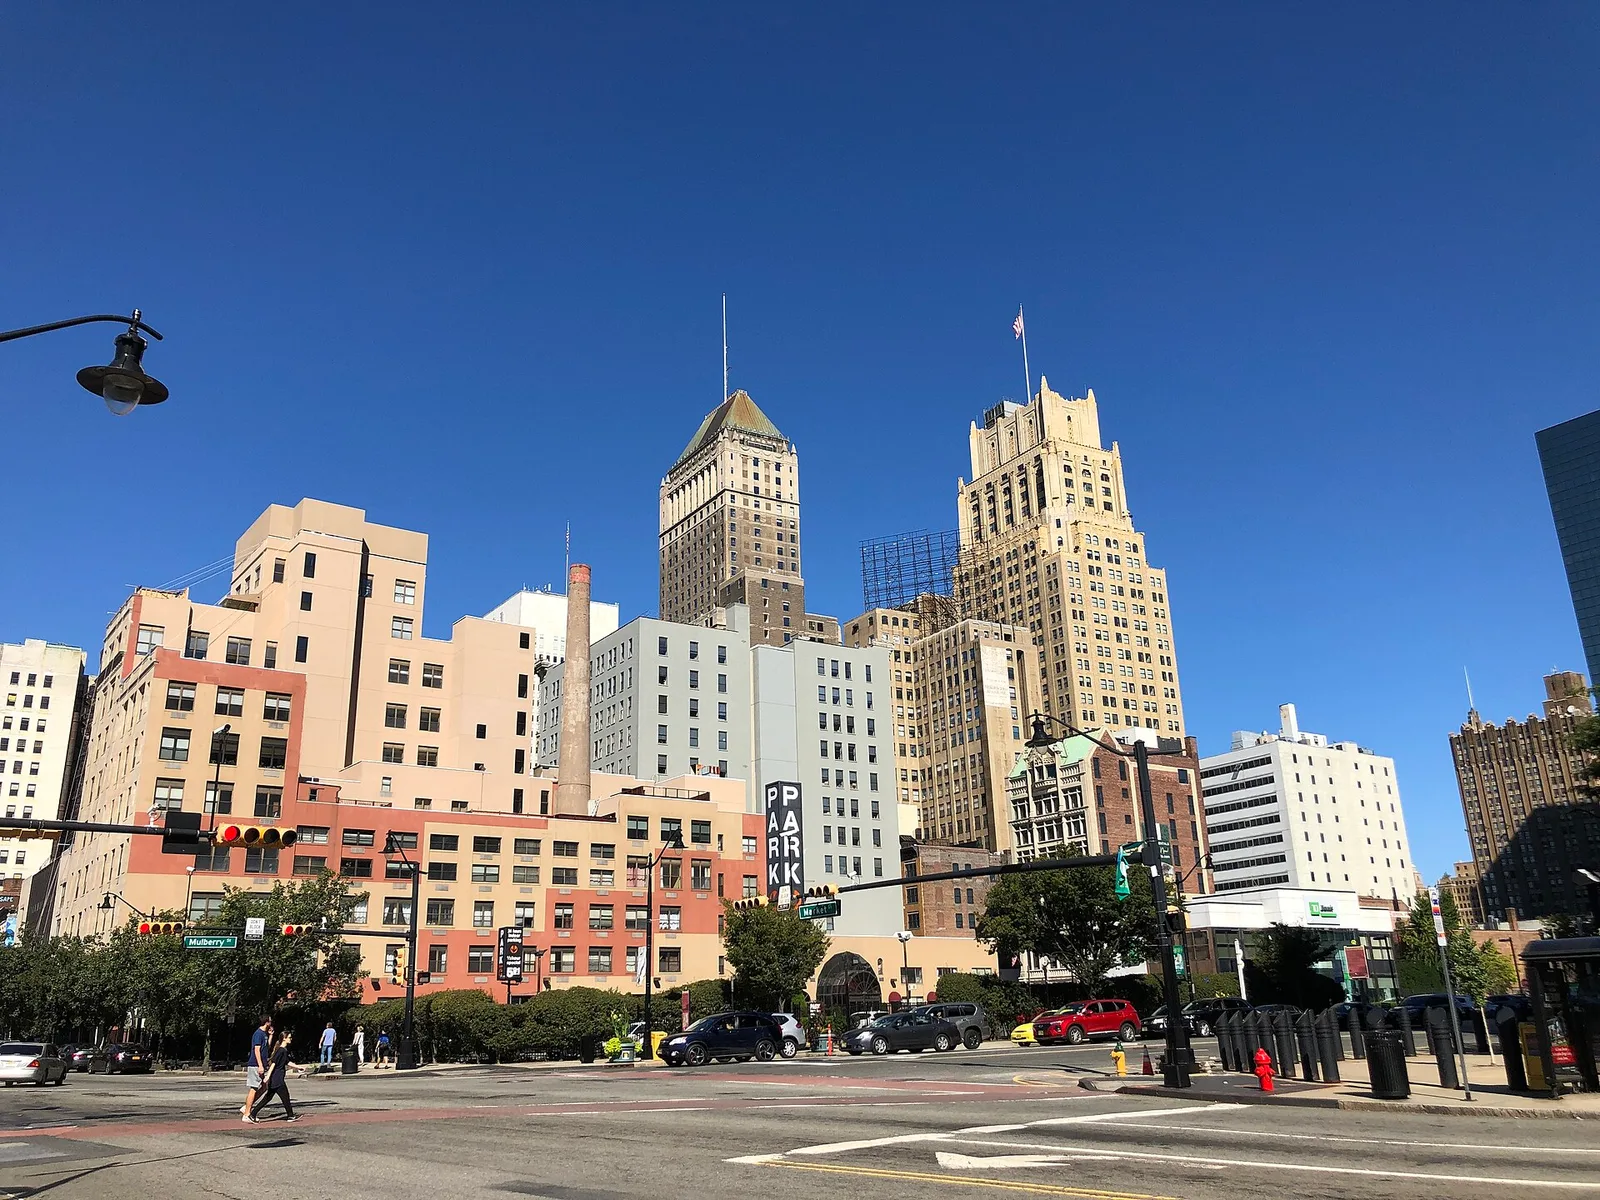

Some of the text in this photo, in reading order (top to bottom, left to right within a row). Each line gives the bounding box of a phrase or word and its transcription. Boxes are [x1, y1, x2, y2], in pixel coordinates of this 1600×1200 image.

[767, 786, 780, 885] PARK
[782, 785, 801, 884] PARK
[803, 906, 827, 917] Market
[189, 939, 225, 947] Mulberry
